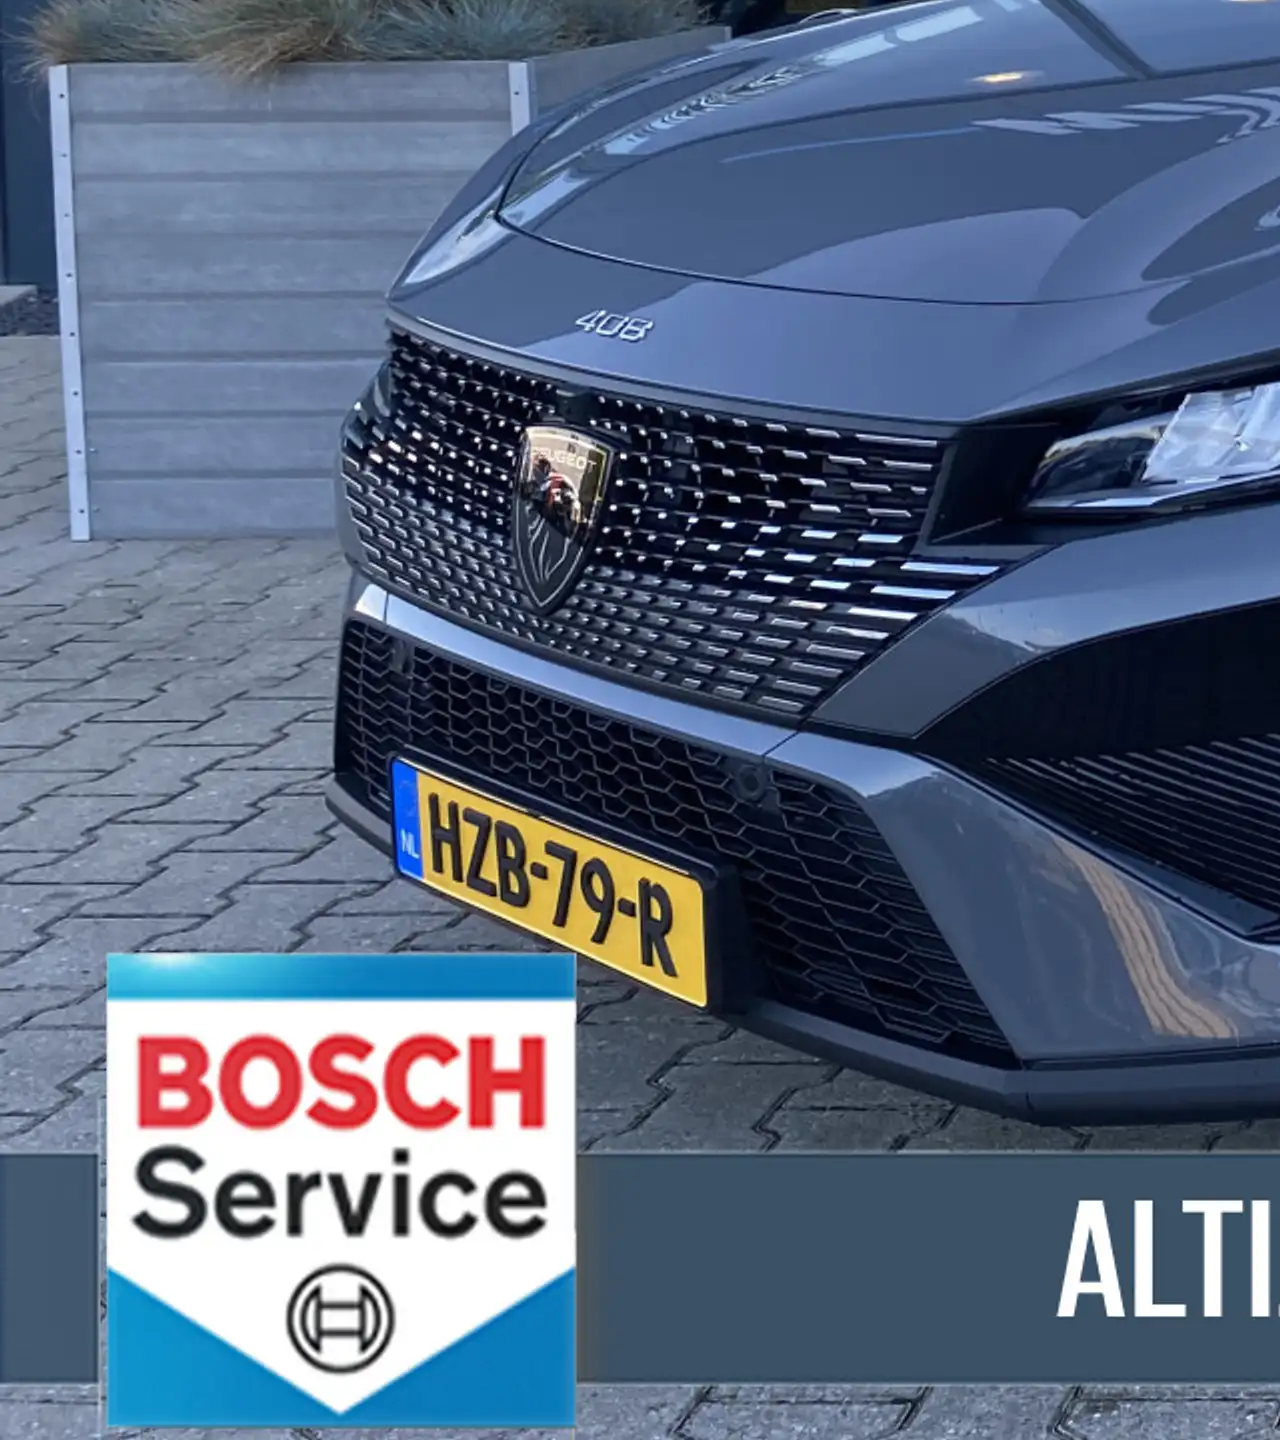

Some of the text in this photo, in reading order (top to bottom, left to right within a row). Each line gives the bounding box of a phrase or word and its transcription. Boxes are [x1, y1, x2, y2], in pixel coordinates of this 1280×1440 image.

[575, 309, 653, 341] 408
[530, 446, 598, 473] PEUGEOT
[400, 828, 420, 860] NL
[428, 792, 678, 978] HZB-79-R
